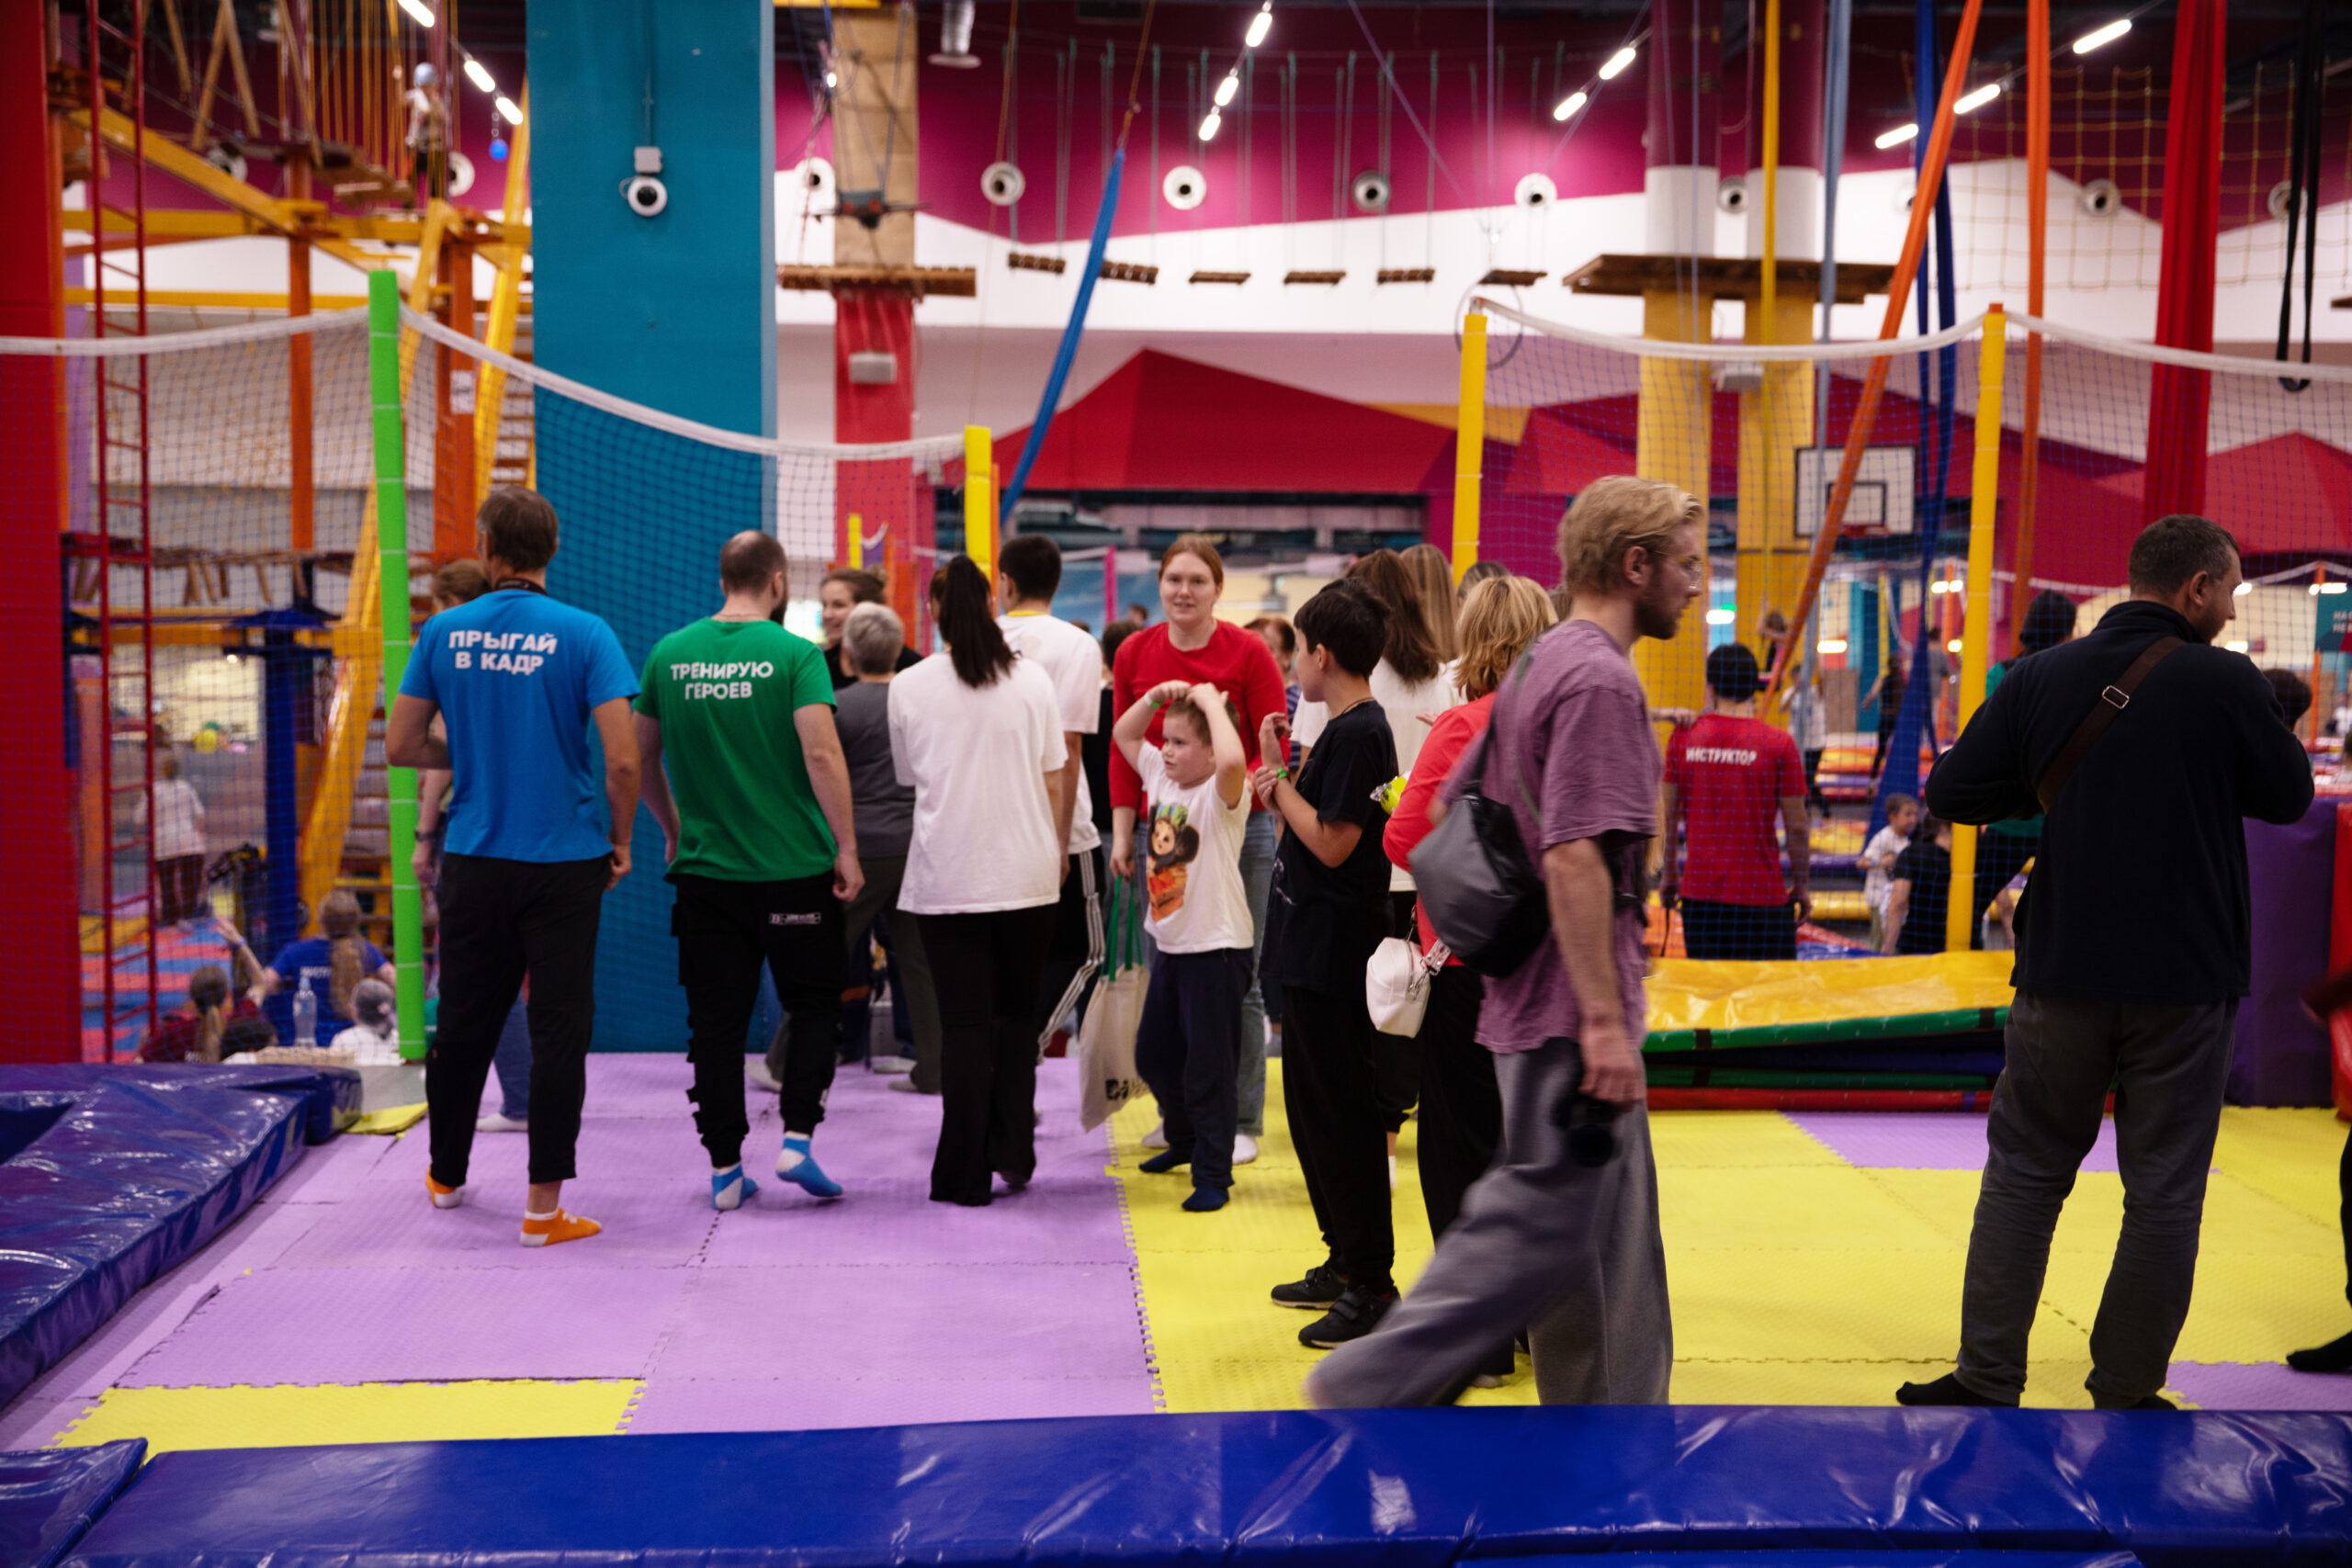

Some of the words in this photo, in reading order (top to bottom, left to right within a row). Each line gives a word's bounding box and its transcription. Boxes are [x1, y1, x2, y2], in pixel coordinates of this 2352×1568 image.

[448, 629, 558, 654] ПРЫГАЙ
[455, 651, 472, 669] В
[480, 652, 544, 675] КАДР
[670, 660, 775, 681] ТРЕНИРУЮ
[684, 681, 752, 700] ГЕРОЕВ
[1687, 747, 1758, 765] ИНСТРУКТОР
